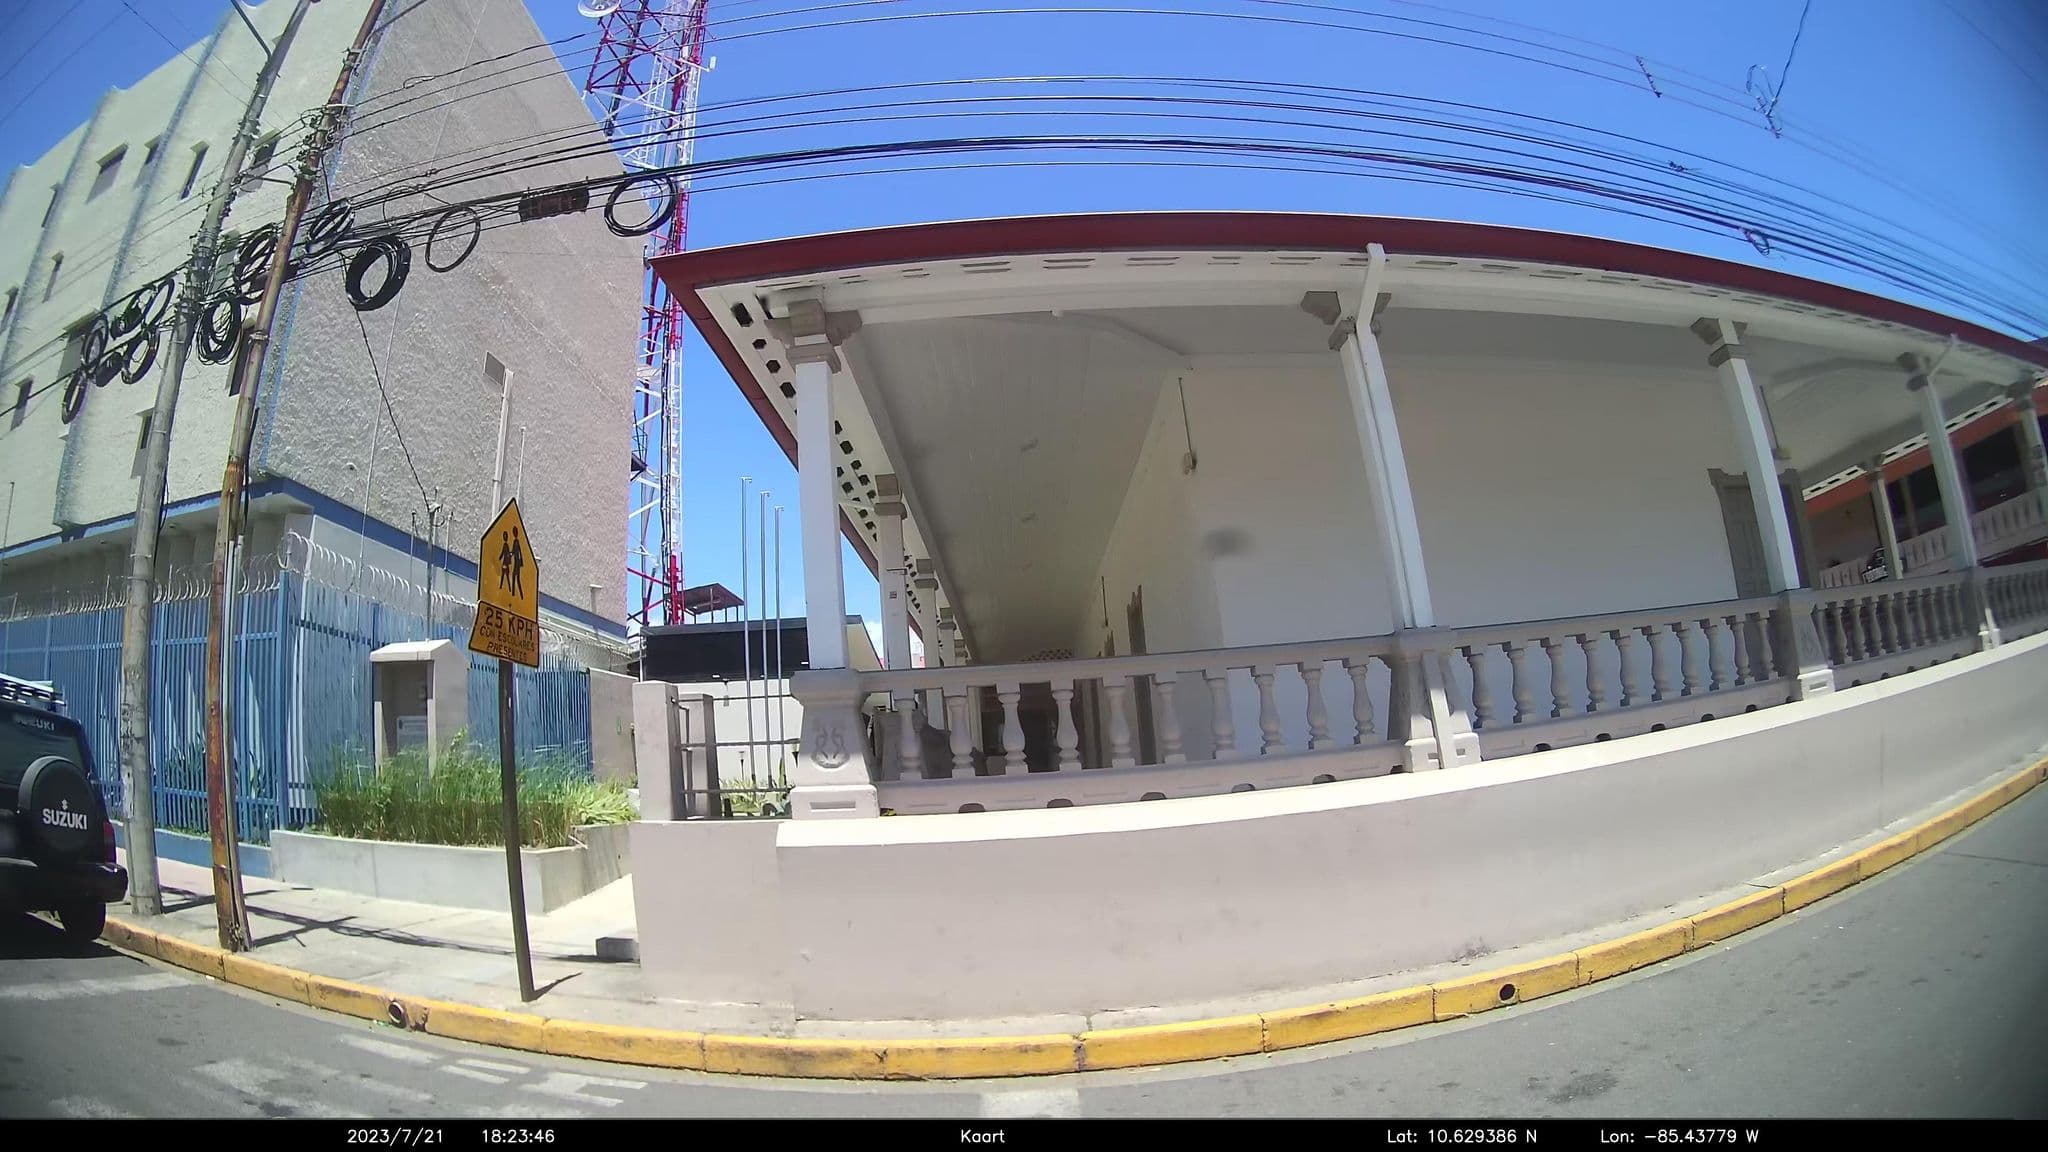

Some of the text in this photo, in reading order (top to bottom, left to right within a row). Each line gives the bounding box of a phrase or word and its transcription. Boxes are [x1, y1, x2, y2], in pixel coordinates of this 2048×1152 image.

[485, 607, 533, 641] 25 KPH
[14, 717, 55, 731] ZUKI
[42, 808, 88, 830] SUZUKI
